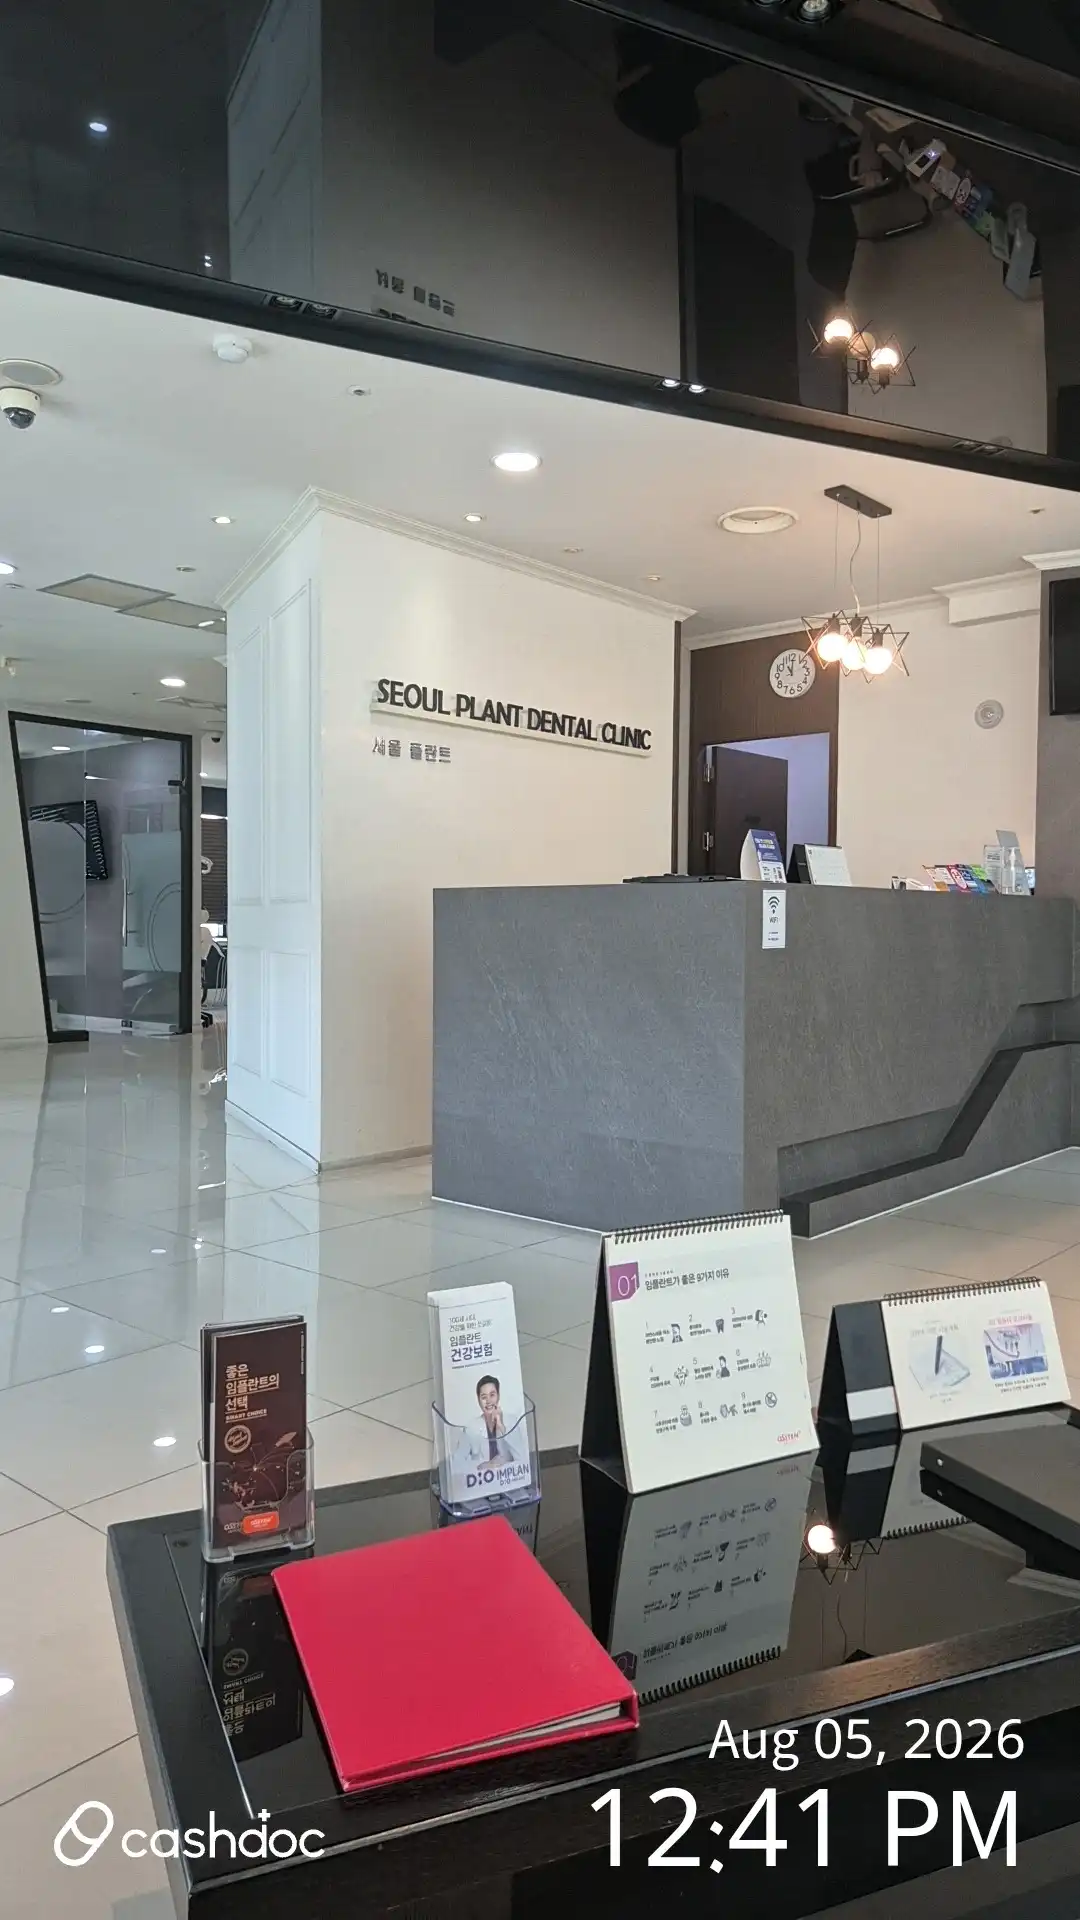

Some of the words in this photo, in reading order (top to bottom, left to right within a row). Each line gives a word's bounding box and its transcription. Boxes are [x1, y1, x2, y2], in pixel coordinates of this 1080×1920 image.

[377, 678, 451, 715] SEOUL
[455, 693, 524, 728] PLANT
[527, 707, 598, 741] DENTAL
[601, 722, 652, 750] CLINIC
[617, 1274, 637, 1296] 01
[449, 1332, 482, 1347] 임플란트
[451, 1343, 493, 1362] 건강보험
[225, 1363, 249, 1379] 좋은
[225, 1372, 279, 1396] 임플란트의
[225, 1395, 248, 1412] 선택
